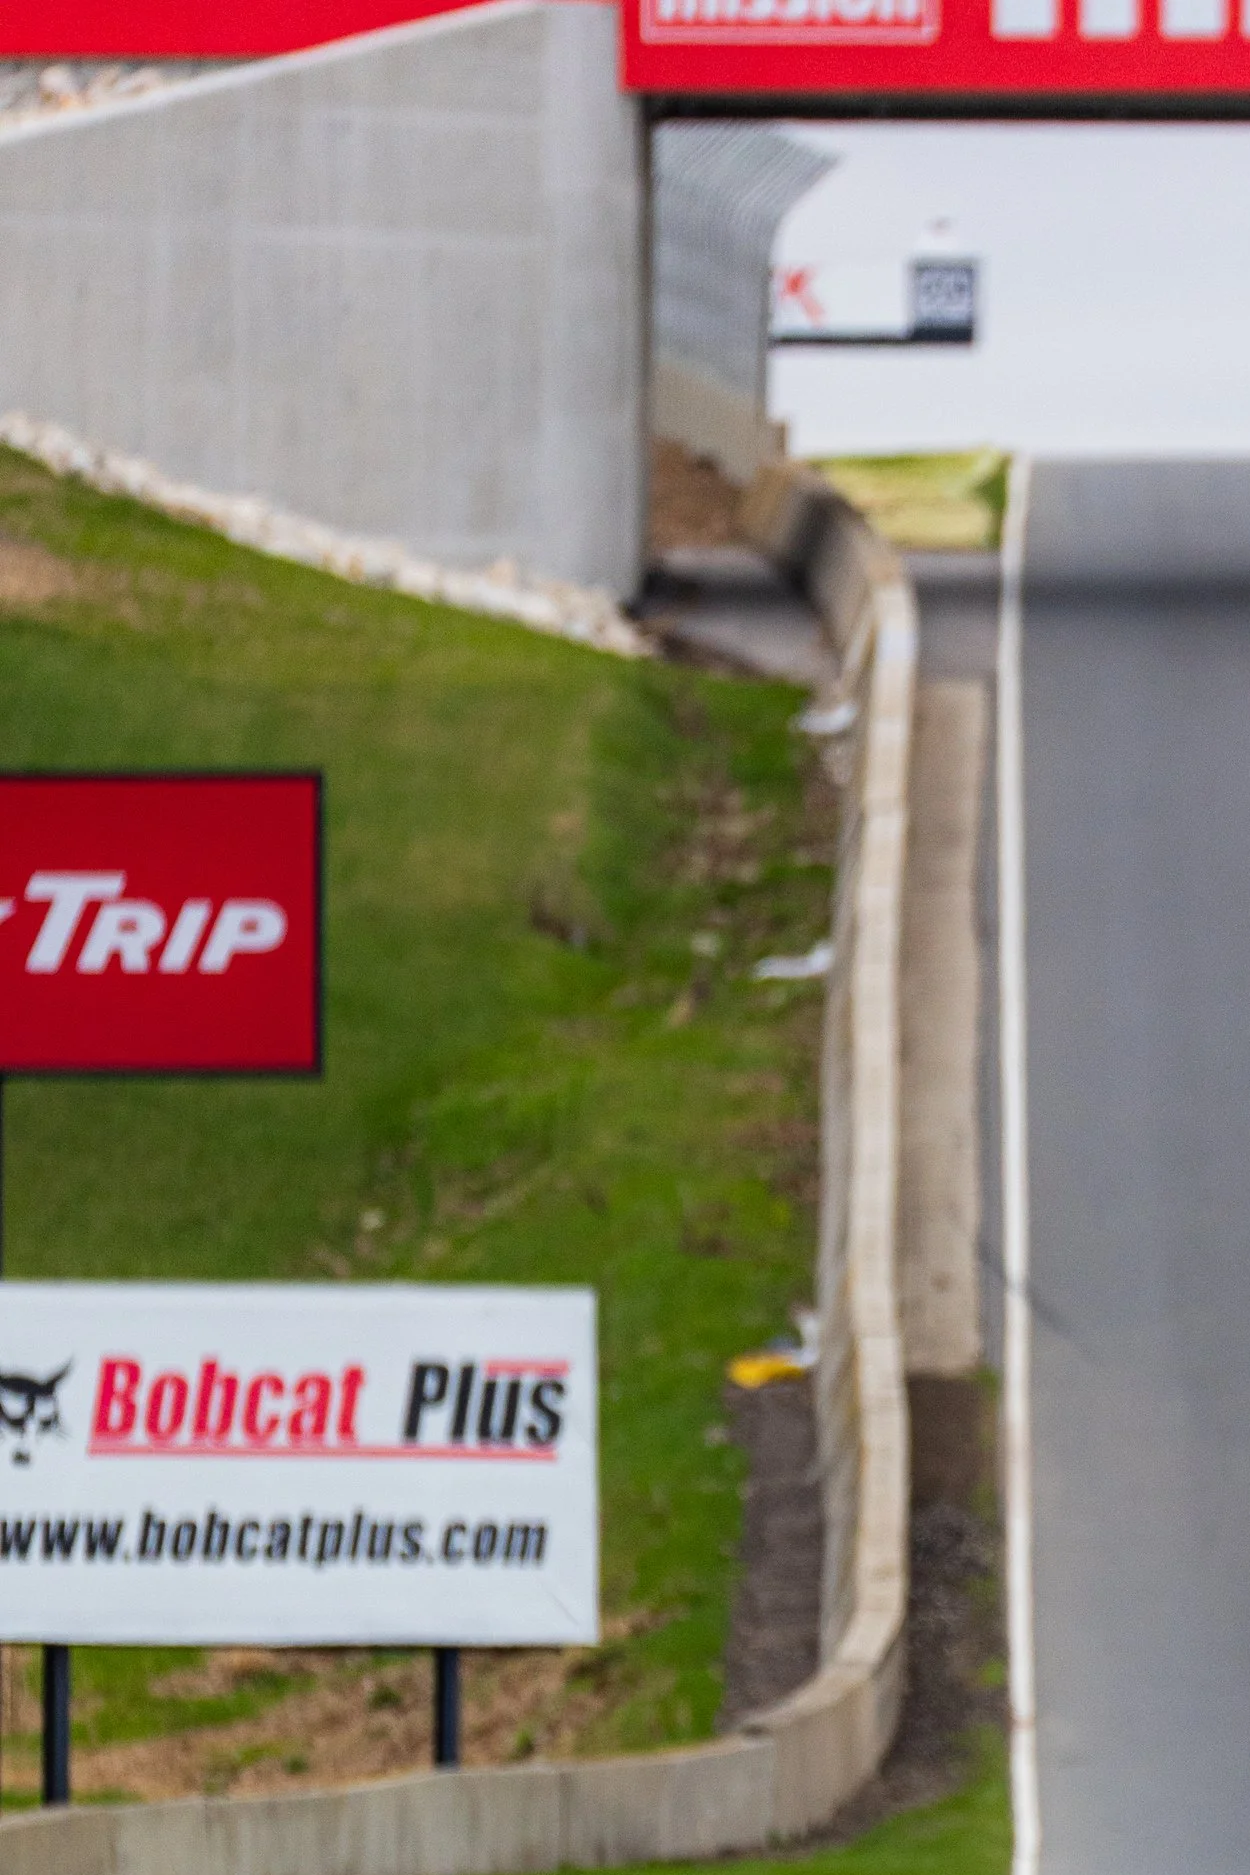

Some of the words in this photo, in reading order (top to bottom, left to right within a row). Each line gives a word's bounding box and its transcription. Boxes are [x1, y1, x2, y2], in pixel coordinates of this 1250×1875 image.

[24, 870, 288, 974] TRIP
[93, 1355, 365, 1445] Bobcat
[403, 1361, 566, 1447] Plus
[0, 1508, 548, 1570] www.bobcatplus.com
